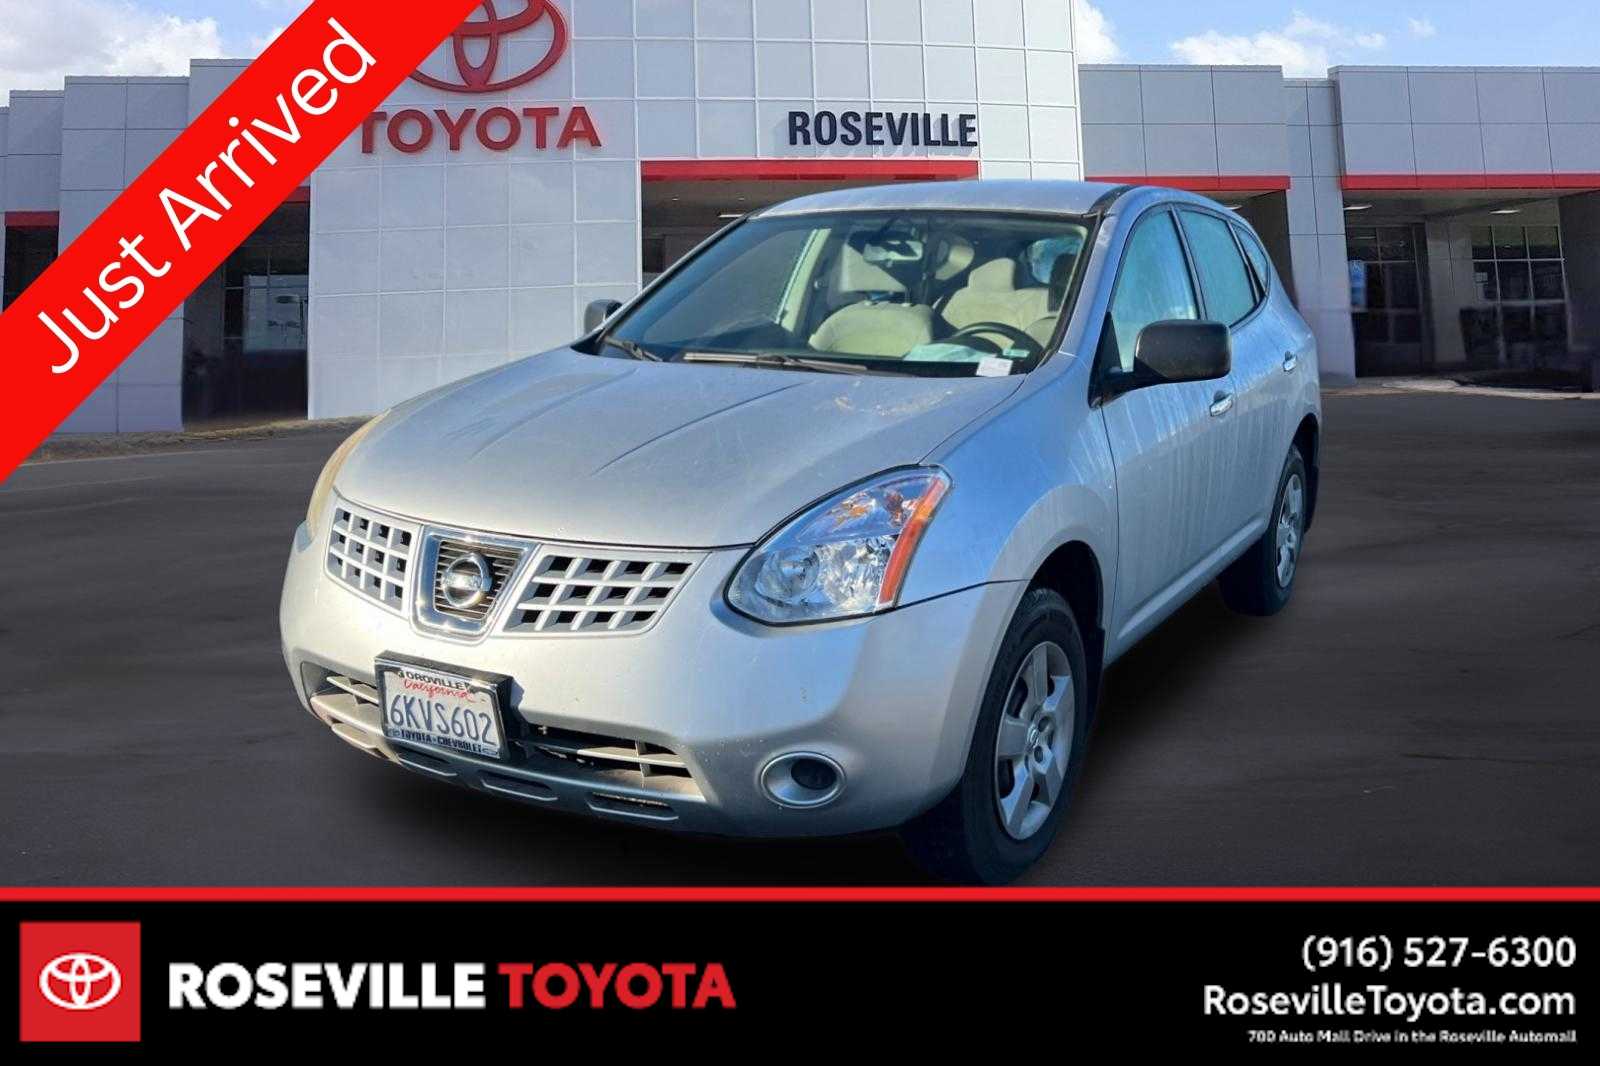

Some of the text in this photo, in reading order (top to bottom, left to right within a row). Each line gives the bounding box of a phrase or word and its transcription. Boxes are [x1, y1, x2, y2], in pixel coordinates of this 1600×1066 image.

[361, 106, 602, 154] TOYOTA
[789, 111, 978, 147] ROSEVILLE
[406, 671, 465, 690] OROVILLE
[390, 694, 496, 745] 6KVS602
[401, 728, 432, 743] TOYOTA
